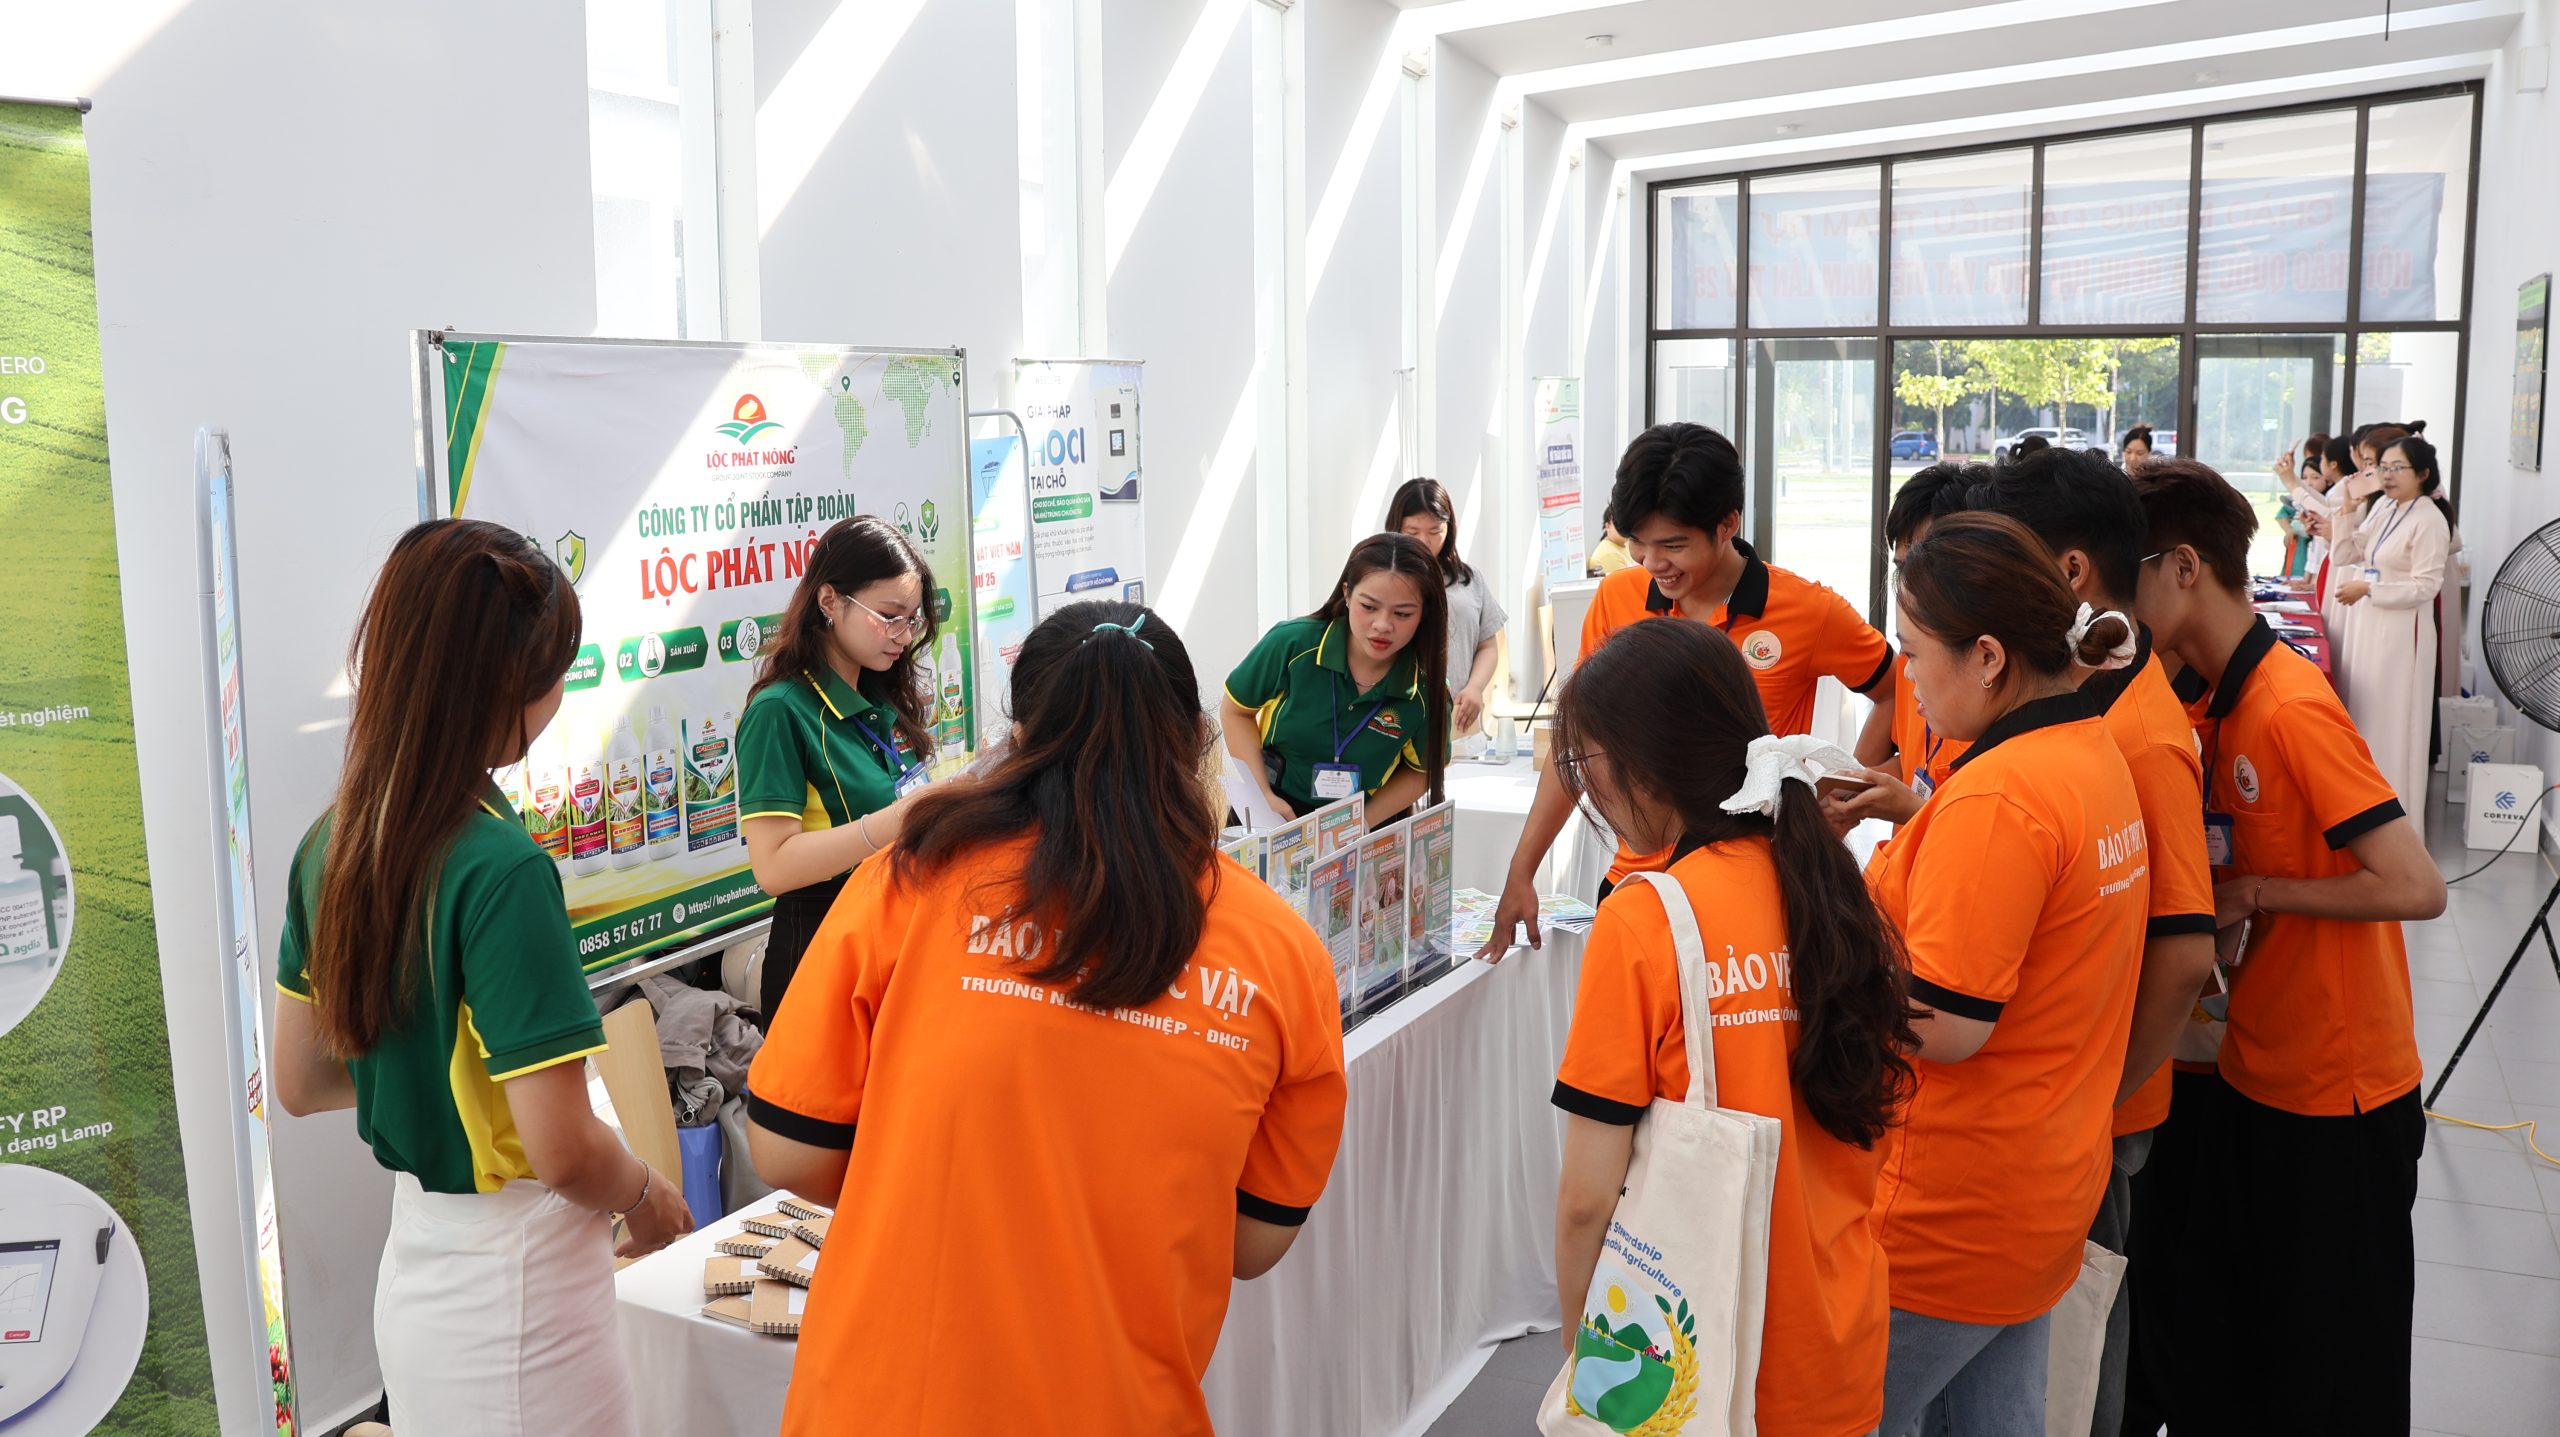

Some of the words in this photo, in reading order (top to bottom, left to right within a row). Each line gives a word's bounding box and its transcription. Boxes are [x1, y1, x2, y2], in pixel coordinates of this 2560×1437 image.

[0, 356, 45, 375] ERO
[0, 396, 27, 425] G
[706, 450, 729, 472] LỘC
[762, 447, 795, 466] NÔNG
[767, 470, 792, 479] COMPANY
[1030, 476, 1045, 493] TẠI
[1045, 467, 1067, 489] CHỖ
[638, 502, 686, 538] CÔNG
[690, 505, 709, 533] TY
[714, 491, 736, 531] CỔ
[740, 490, 782, 529] PHẦN
[786, 492, 813, 530] TẬP
[817, 489, 856, 522] ĐOÀN
[1057, 497, 1066, 506] BẢO
[1005, 540, 1021, 557] NAM
[640, 546, 698, 607] LỘC
[706, 536, 776, 591] PHÁT
[783, 529, 819, 580] NÔ
[985, 572, 996, 588] 25
[669, 646, 682, 657] SẢN
[682, 643, 698, 655] XUẤT
[720, 635, 732, 650] 03
[619, 652, 633, 669] 02
[564, 670, 583, 682] CUNG
[583, 667, 598, 680] ỨNG
[21, 704, 89, 727] nghiệm
[2483, 812, 2525, 821] CORTEVA
[2097, 824, 2124, 870] BẢO
[688, 882, 762, 915] https://locphatnong.
[2099, 878, 2130, 897] TRƯỜNG
[579, 931, 610, 955] 0858
[613, 925, 627, 943] 57
[630, 918, 645, 937] 67
[648, 912, 663, 931] 77
[966, 904, 1043, 961] BẢO
[13, 940, 41, 956] agdia
[1706, 944, 1768, 999] BẢO
[1199, 966, 1259, 1021] VẬT
[961, 975, 1044, 1002] TRƯỜNG
[1113, 1006, 1188, 1036] NGHIỆP
[1206, 1028, 1250, 1052] ĐHCT
[1711, 1008, 1781, 1027] TRƯỜNG
[32, 1105, 67, 1129] RP
[7, 1132, 57, 1155] dạng
[61, 1121, 113, 1143] Lamp
[1613, 1221, 1663, 1261] Stewardship
[1621, 1246, 1682, 1298] Agriculture
